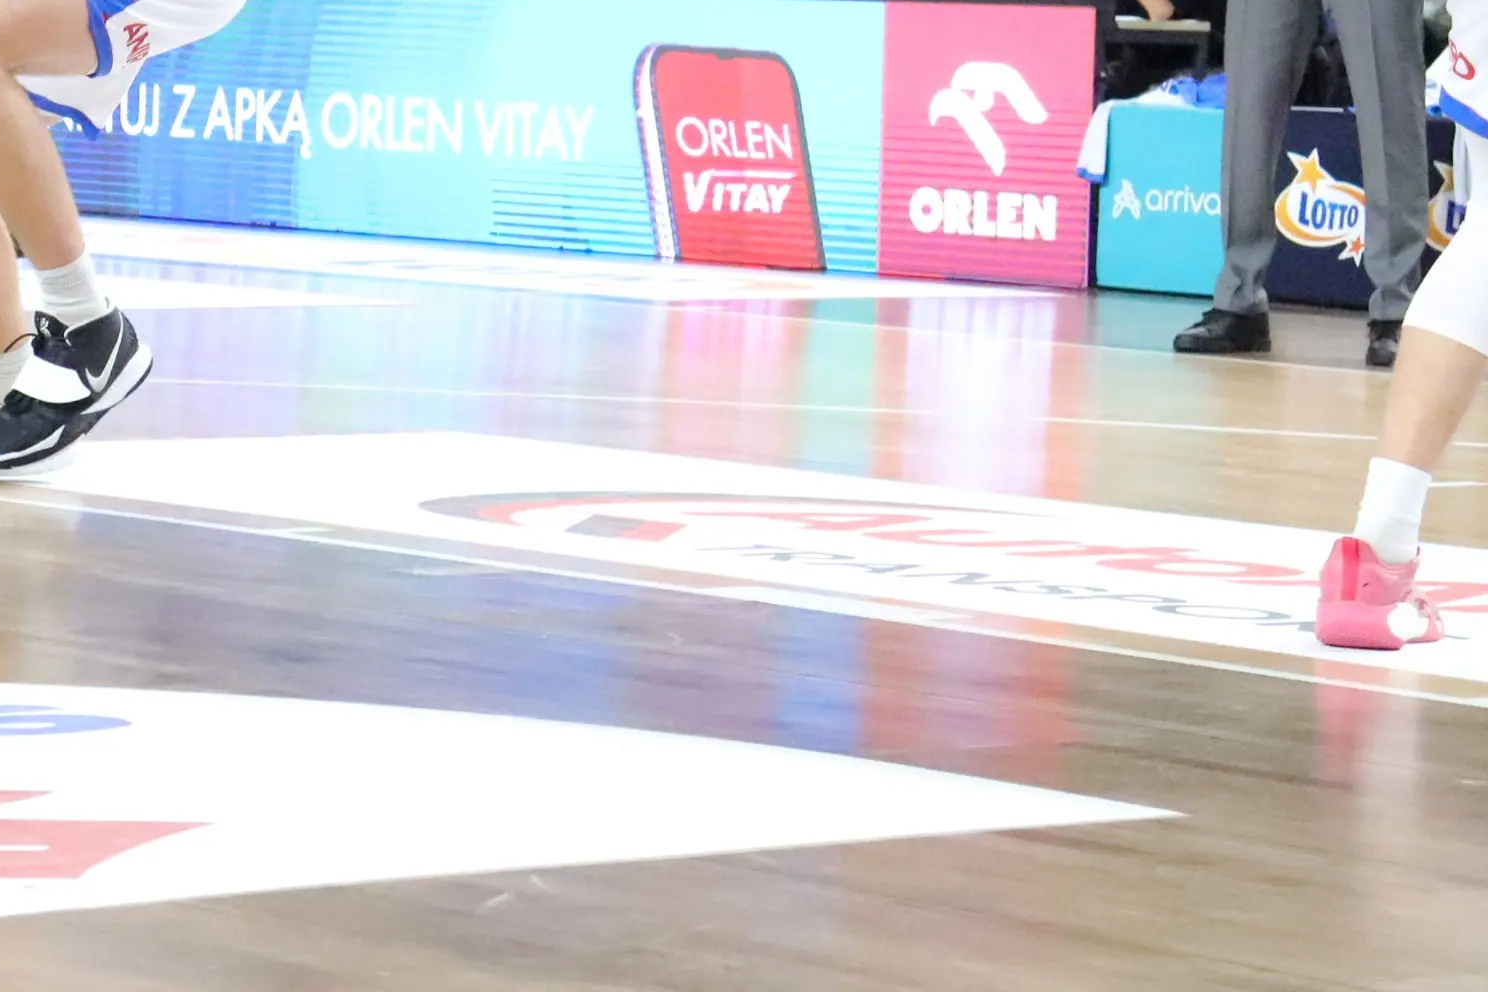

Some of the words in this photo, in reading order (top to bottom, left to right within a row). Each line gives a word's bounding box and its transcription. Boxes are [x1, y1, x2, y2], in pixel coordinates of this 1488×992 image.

[170, 83, 197, 138] Z
[202, 85, 312, 158] APKĄ
[320, 90, 465, 155] ORLEN
[476, 100, 596, 162] VITAY
[676, 116, 793, 161] ORLEN
[908, 186, 1058, 242] ORLEN
[1144, 184, 1222, 216] arriva
[1298, 191, 1359, 230] LOTTO
[696, 542, 1470, 640] TRANSPO
